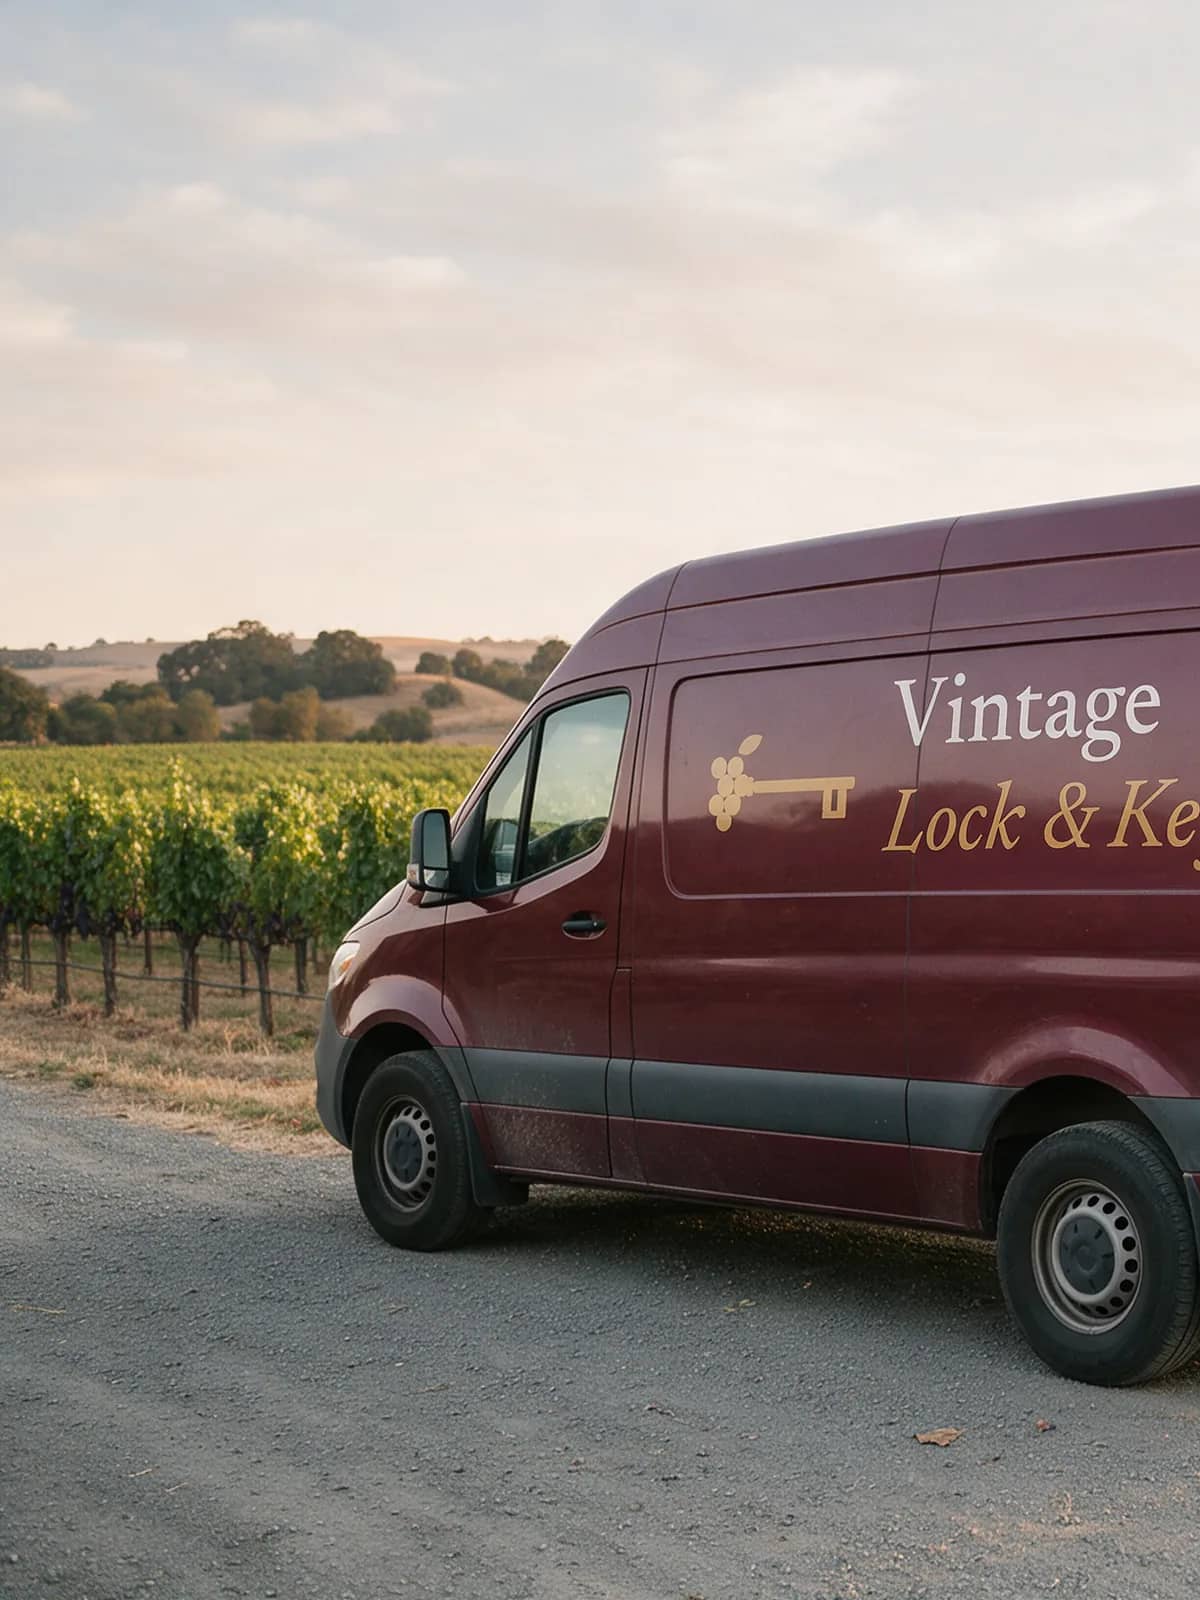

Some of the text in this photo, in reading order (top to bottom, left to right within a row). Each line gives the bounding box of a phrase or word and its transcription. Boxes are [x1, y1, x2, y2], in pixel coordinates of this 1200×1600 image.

[894, 672, 1161, 763] Vintage
[881, 779, 1026, 854] Lock
[1043, 781, 1100, 849] &
